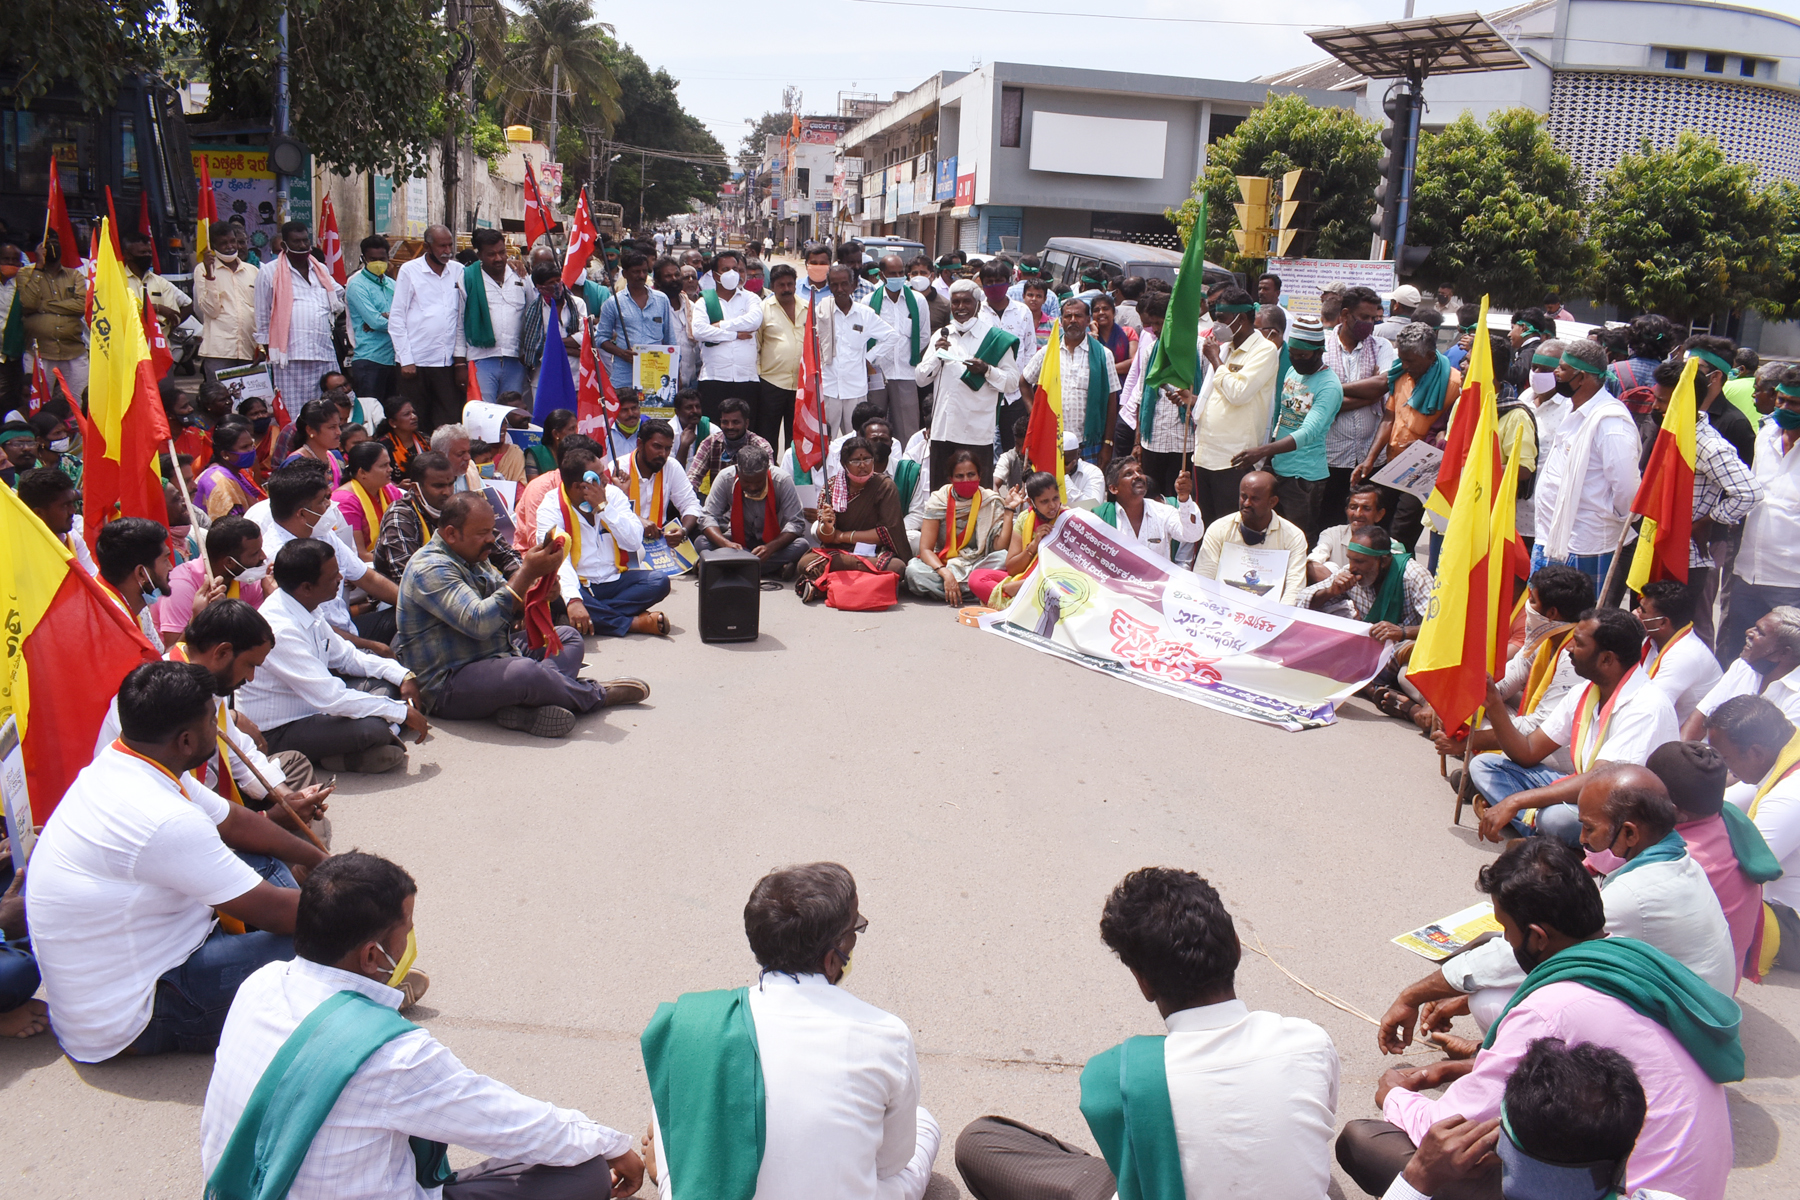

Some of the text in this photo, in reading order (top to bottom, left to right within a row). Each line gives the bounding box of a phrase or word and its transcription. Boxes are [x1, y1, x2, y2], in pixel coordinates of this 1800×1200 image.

[1056, 542, 1091, 570] ಮಸೂದೆಗಳ
[1062, 530, 1077, 543] ರೈತ
[1079, 543, 1097, 558] ದಲಿತ
[1100, 558, 1130, 579] ಕಾರ್ಮಿಕ
[1069, 520, 1120, 557] ಬಿಜೆಪಿ ಸರ್ಕಾರಗಳ
